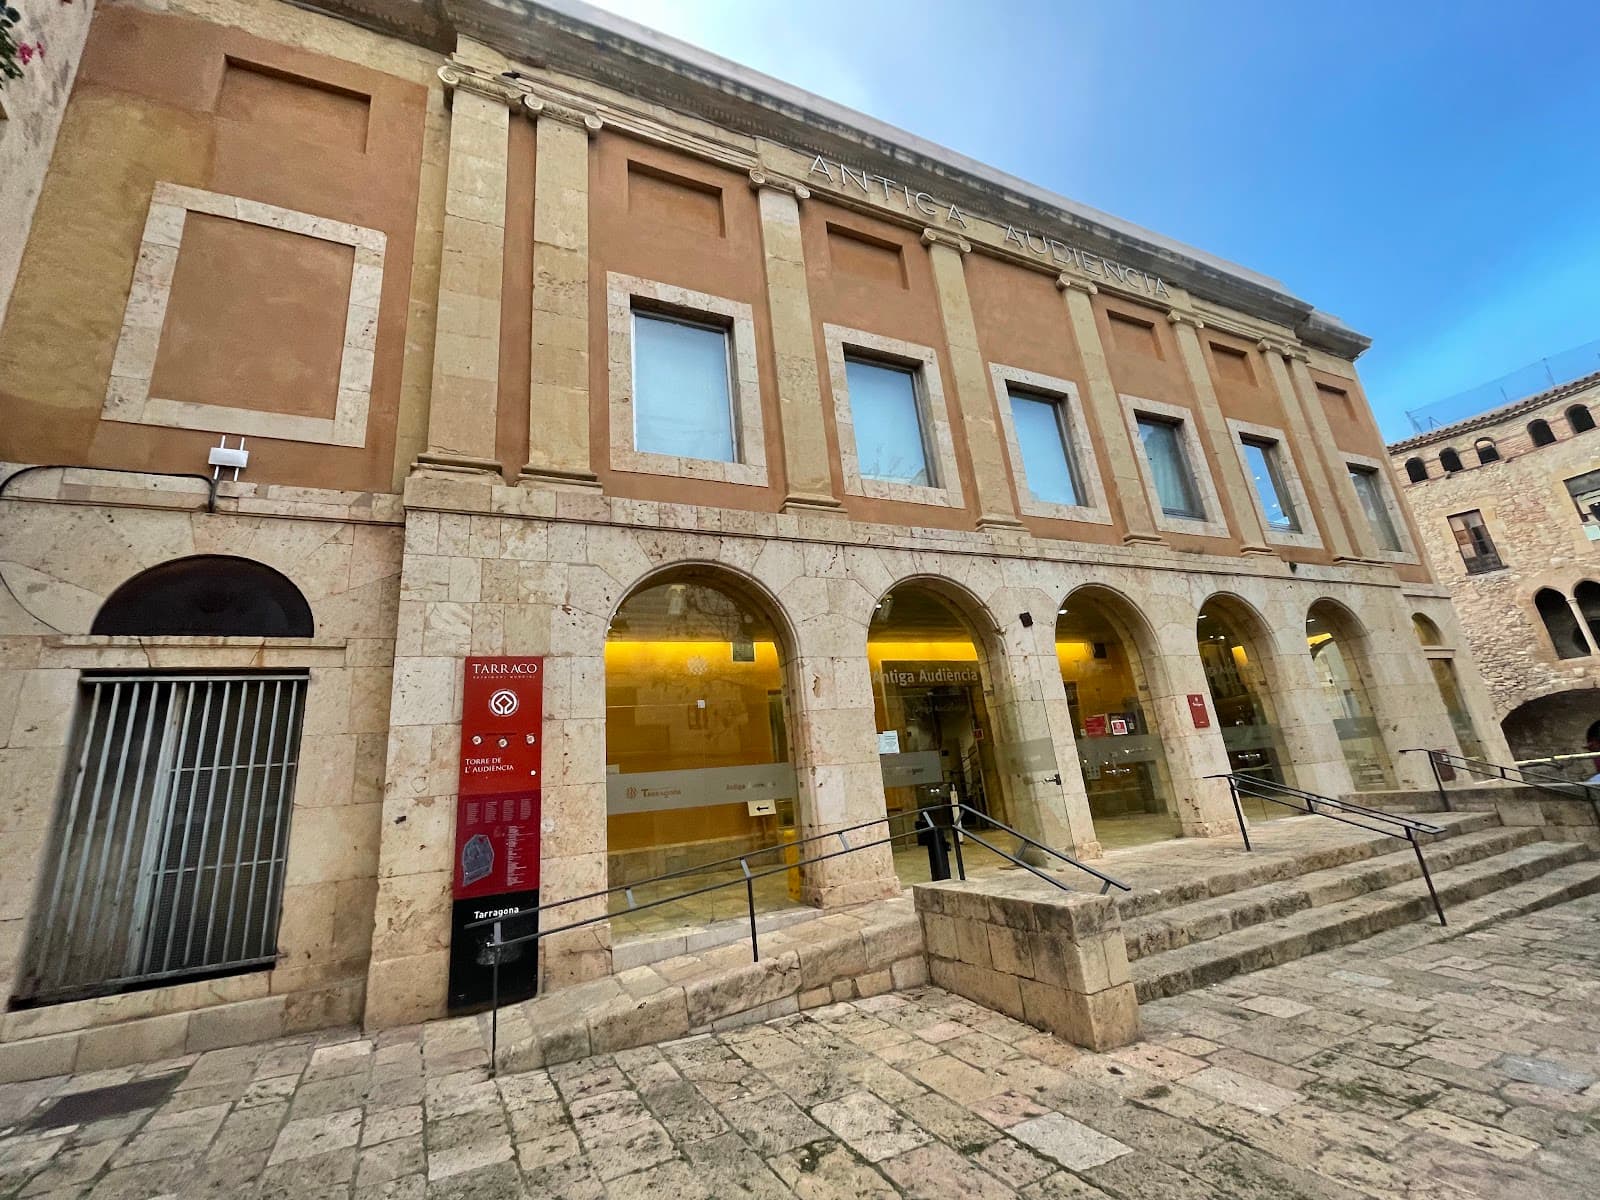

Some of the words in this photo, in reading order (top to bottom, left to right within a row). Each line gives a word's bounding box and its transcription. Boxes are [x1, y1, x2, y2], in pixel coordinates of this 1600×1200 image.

[809, 155, 968, 229] ANTIGA
[1005, 224, 1171, 299] AUDIENCIA
[472, 663, 538, 674] TARRACO
[872, 669, 915, 686] Antiga
[919, 667, 978, 682] Audiència
[465, 758, 489, 766] TORRE
[473, 906, 520, 920] Tarragona
